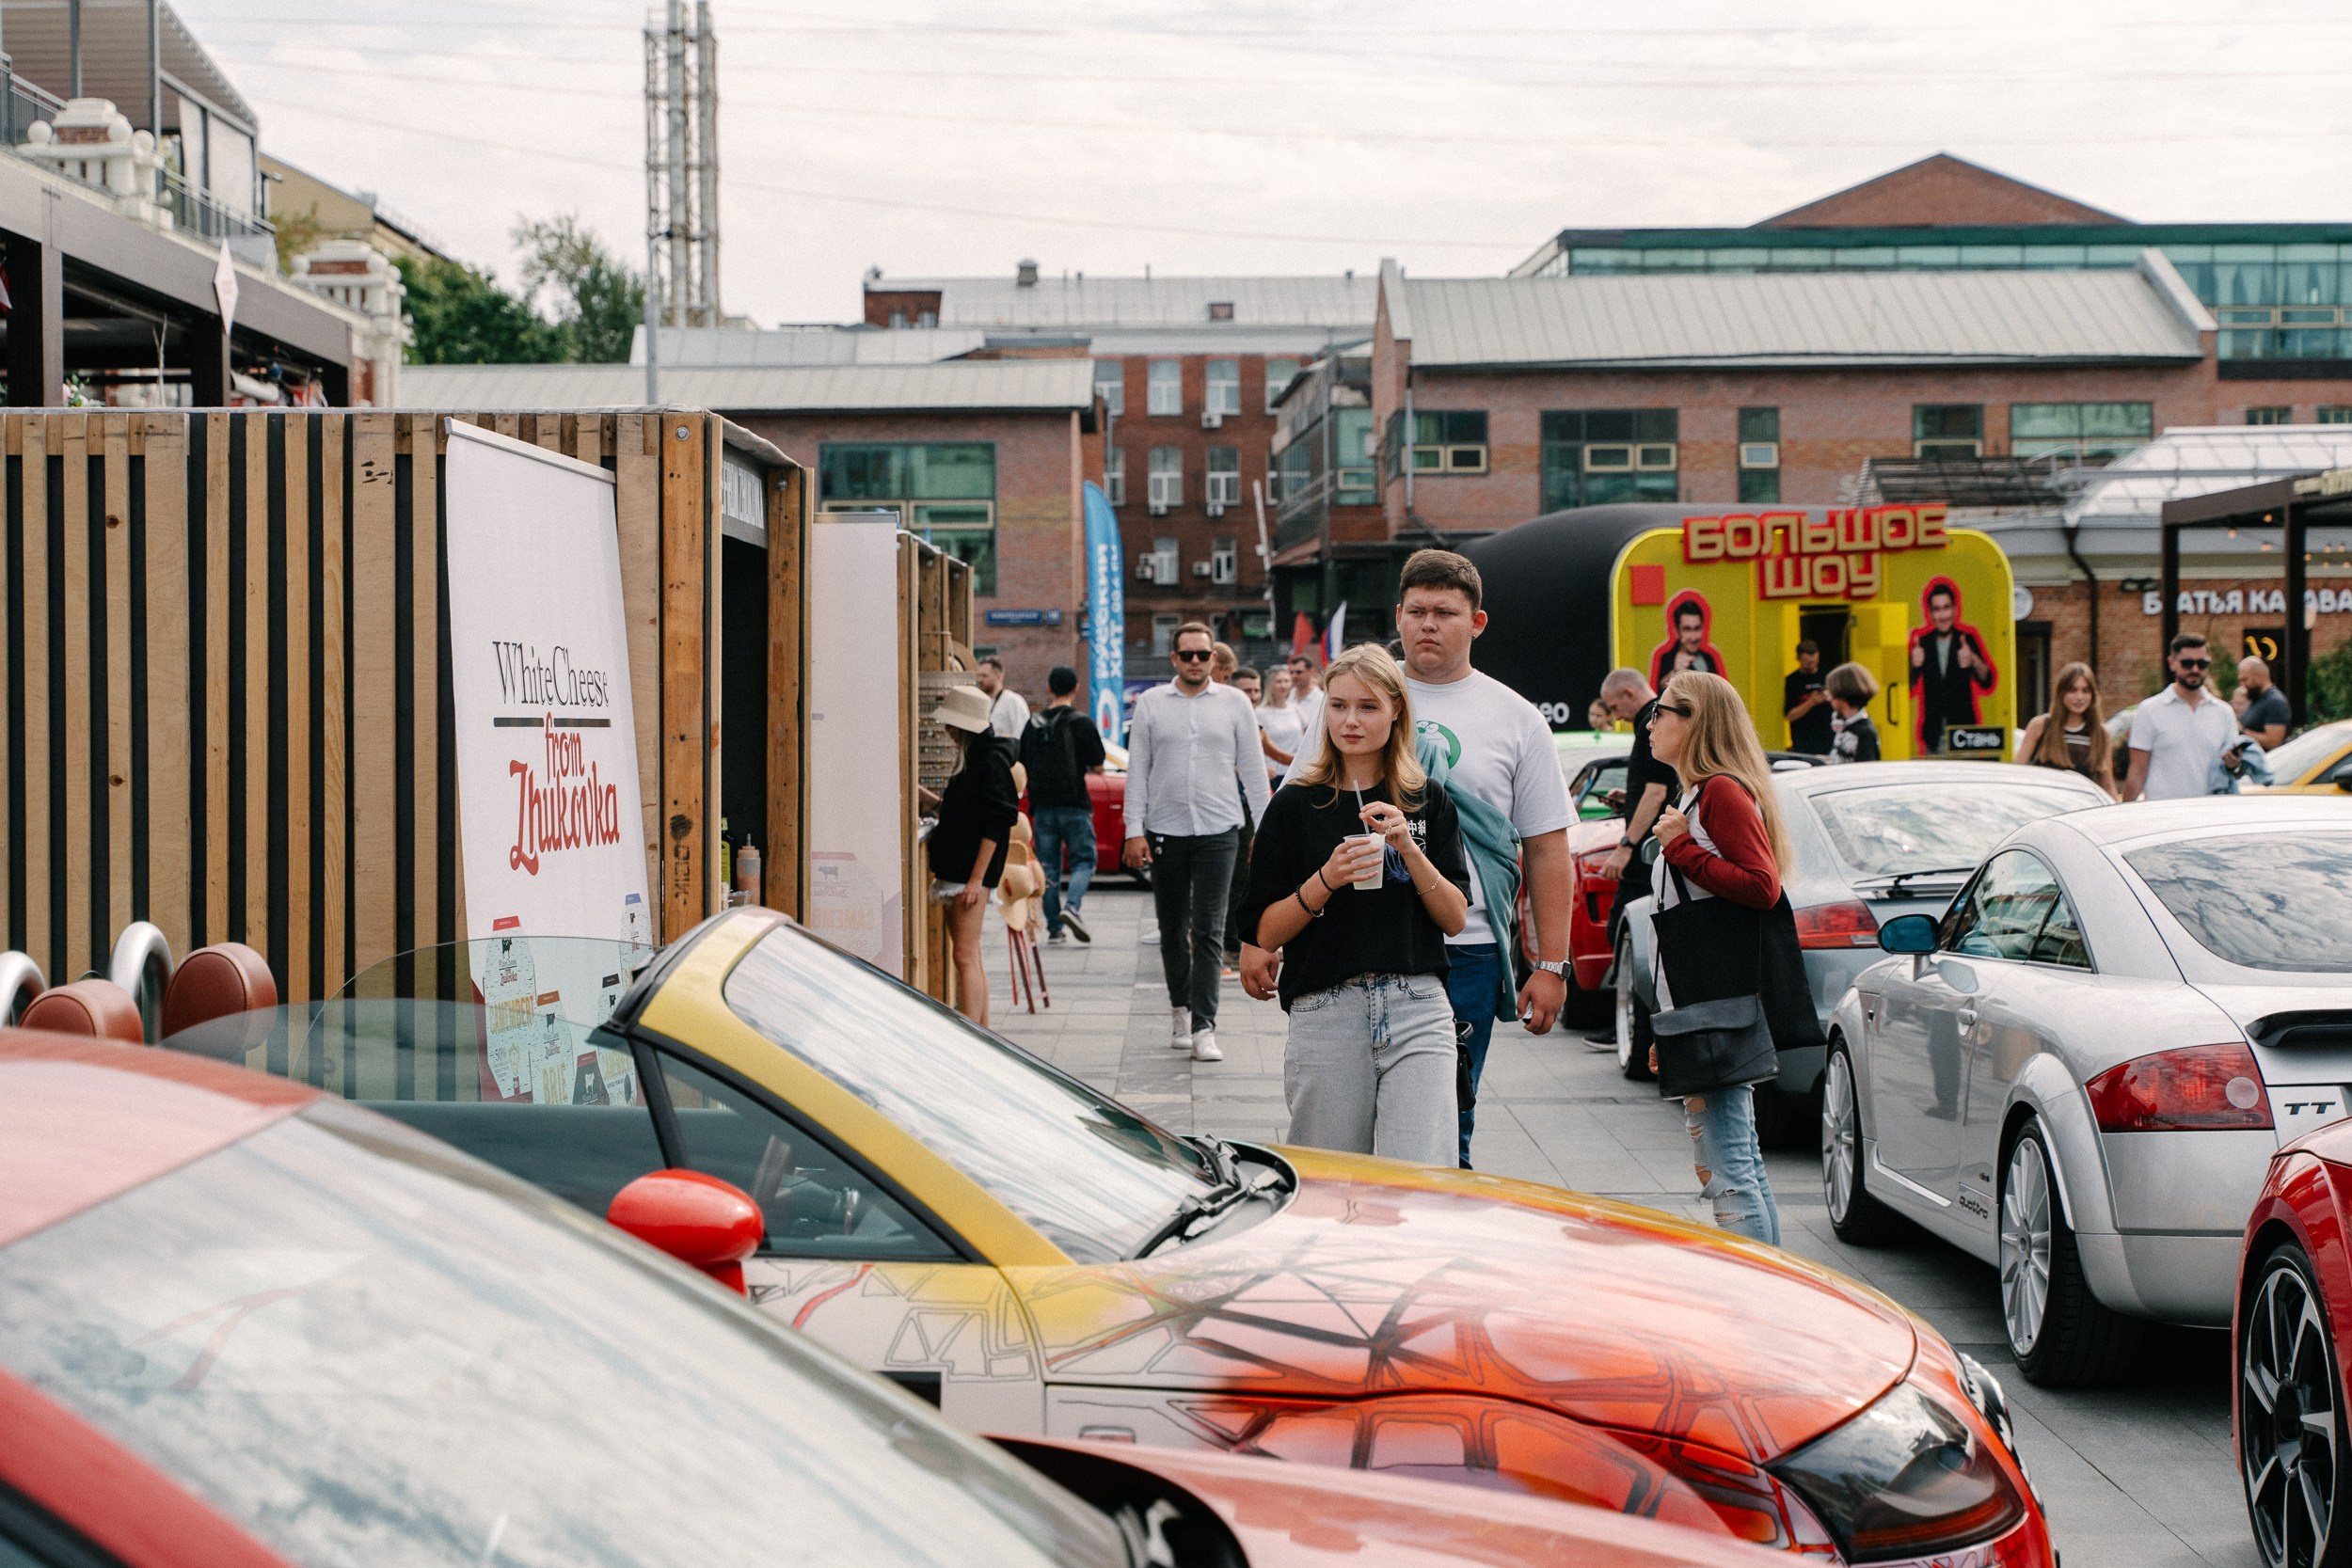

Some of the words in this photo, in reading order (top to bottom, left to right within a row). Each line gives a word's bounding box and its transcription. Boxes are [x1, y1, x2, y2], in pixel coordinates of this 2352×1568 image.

[1684, 503, 1950, 562] БОЛЬШОЕ
[1758, 553, 1881, 600] ШОУ
[2142, 589, 2244, 615] БАТЬЯ
[2249, 589, 2352, 613] КААВА
[492, 641, 610, 707] WhiteCheese
[1532, 702, 1570, 724] ео
[545, 711, 585, 784] from
[1952, 729, 2001, 749] Стань
[510, 759, 620, 876] Zhukovka
[489, 994, 534, 1034] CAMEMBERT
[542, 1063, 569, 1106] BRIE
[2284, 1101, 2336, 1115] TT
[1959, 1196, 1989, 1219] quattro
